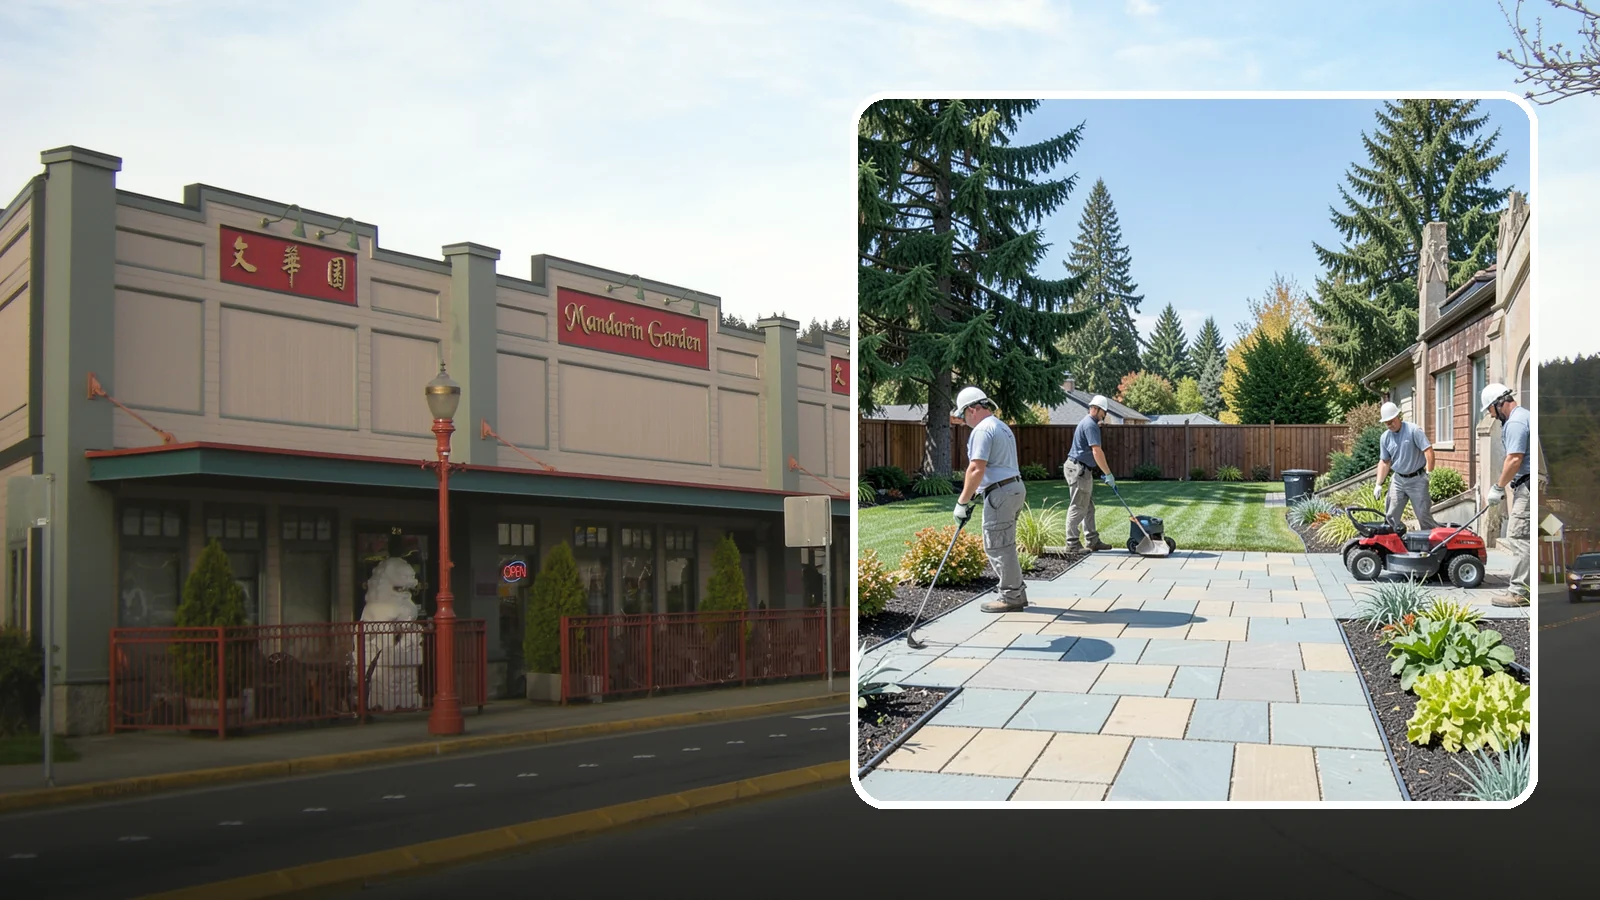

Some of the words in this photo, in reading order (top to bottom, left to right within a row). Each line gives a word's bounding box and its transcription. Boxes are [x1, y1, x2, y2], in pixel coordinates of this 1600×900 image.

[230, 235, 346, 291] 文華園
[564, 302, 644, 341] Mandarin
[647, 320, 702, 352] Garden
[503, 565, 527, 578] OPEN
